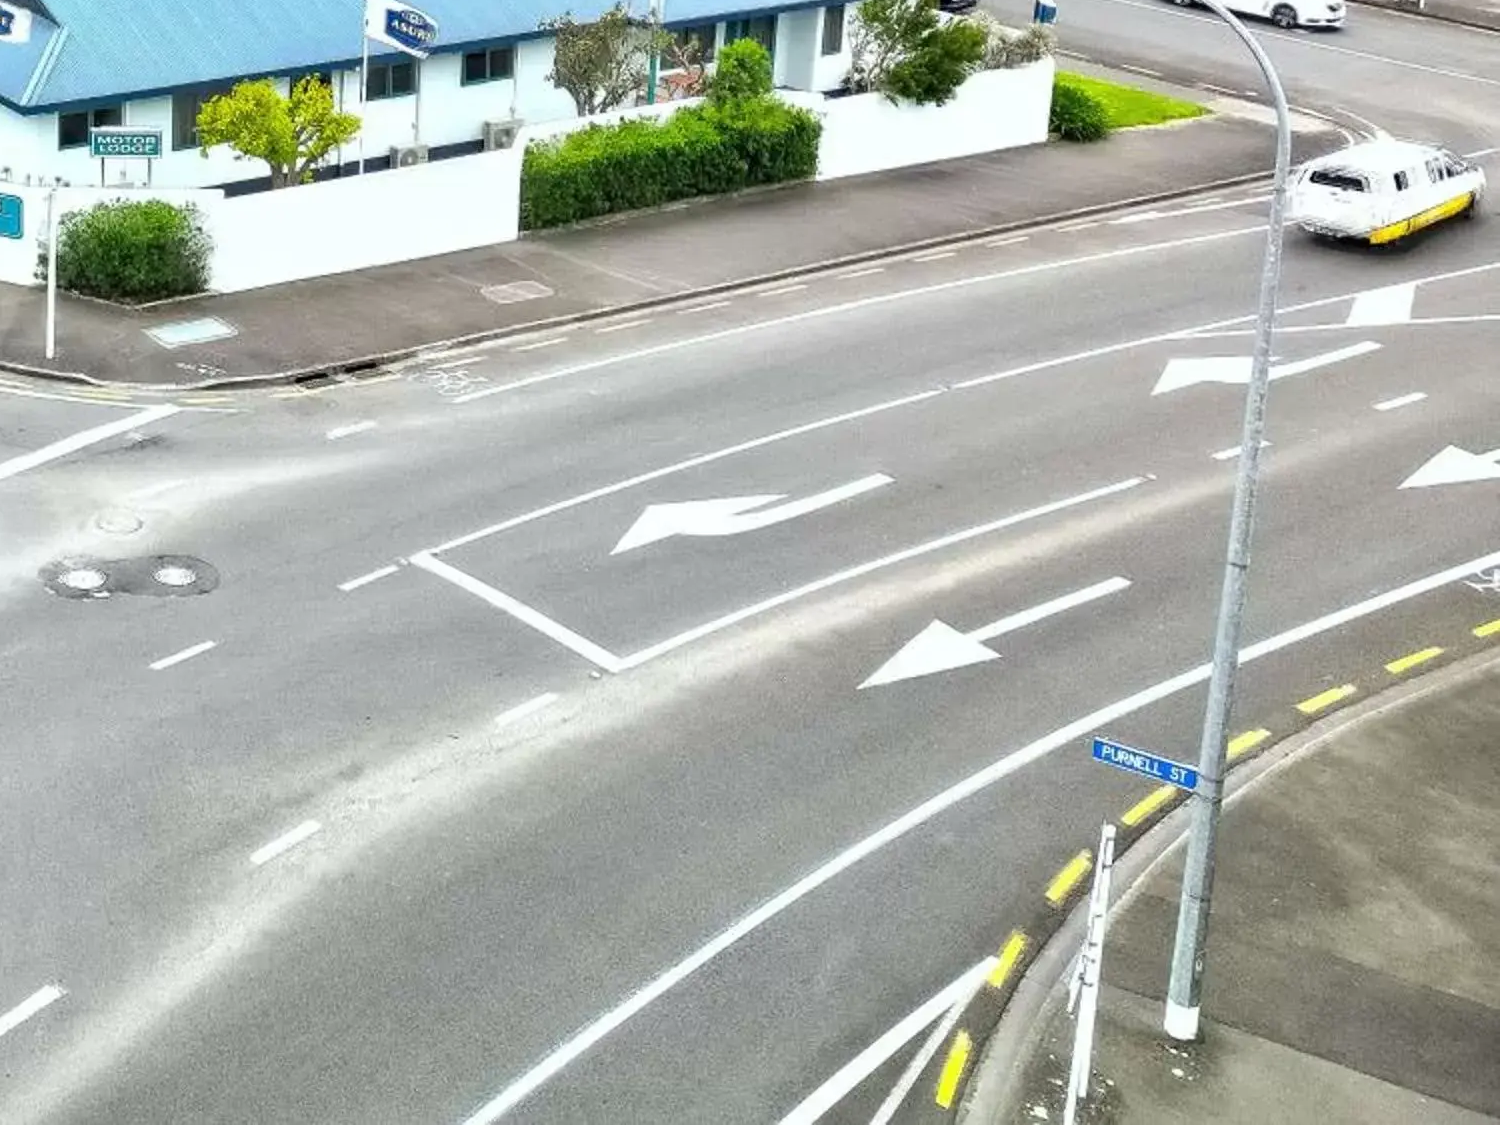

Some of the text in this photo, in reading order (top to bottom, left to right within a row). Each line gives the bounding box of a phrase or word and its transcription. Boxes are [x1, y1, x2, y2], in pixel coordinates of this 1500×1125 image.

[97, 136, 156, 144] MOTOR
[100, 144, 155, 153] LODGE
[1102, 744, 1188, 783] PURNELL ST
